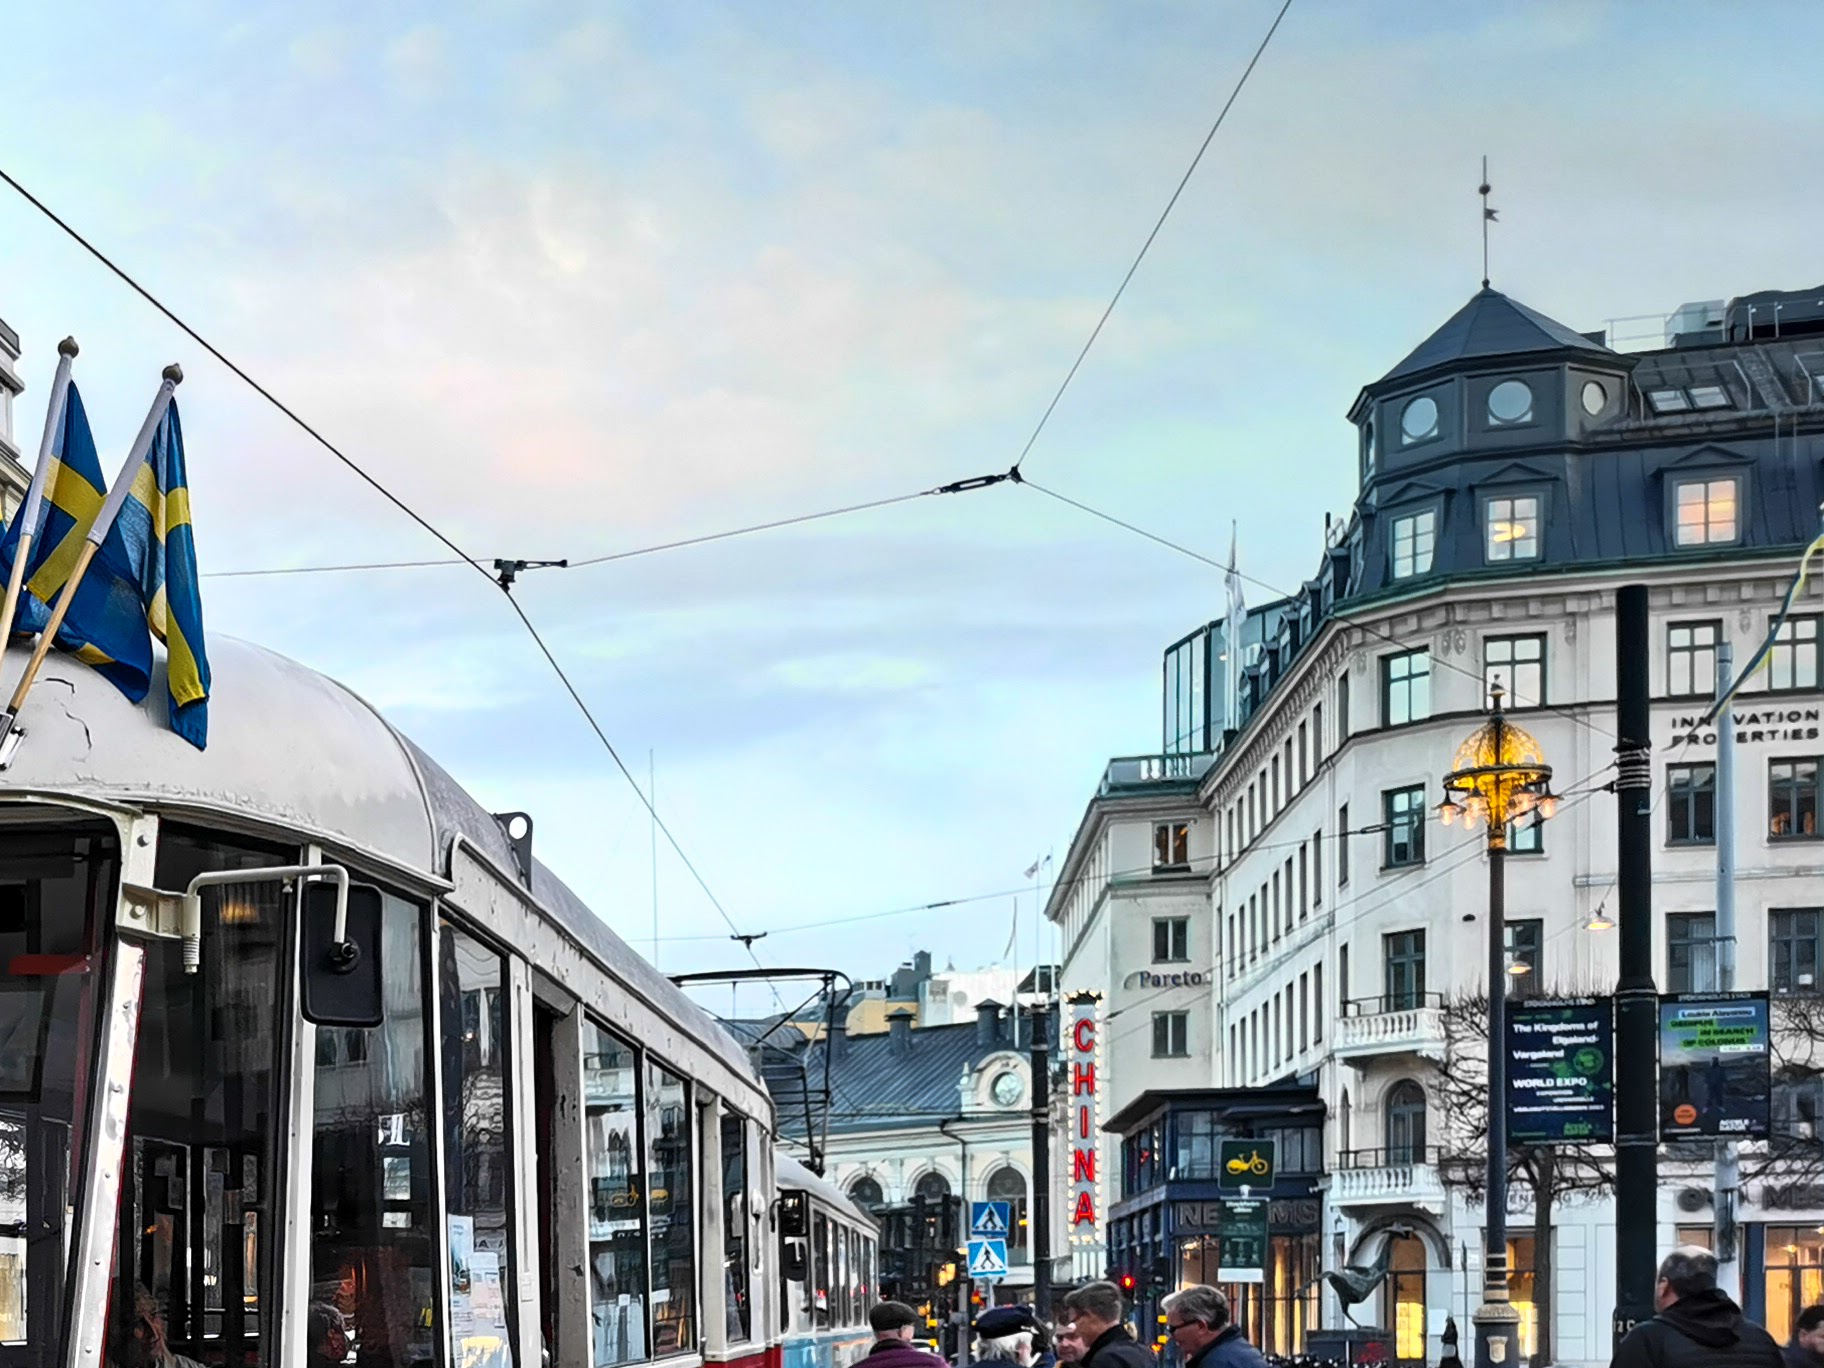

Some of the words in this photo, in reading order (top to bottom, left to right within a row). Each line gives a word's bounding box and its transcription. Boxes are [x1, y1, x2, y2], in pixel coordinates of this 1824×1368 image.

[1671, 709, 1820, 729] INNVATION
[1671, 727, 1820, 746] PROERTIES
[1139, 970, 1203, 988] Pareto
[1513, 1023, 1532, 1033] The
[1533, 1021, 1585, 1034] Kingdoms
[1587, 1020, 1599, 1031] of
[1513, 1077, 1555, 1089] WORLD
[1556, 1077, 1588, 1087] EXPO
[1073, 1017, 1095, 1226] CHINA
